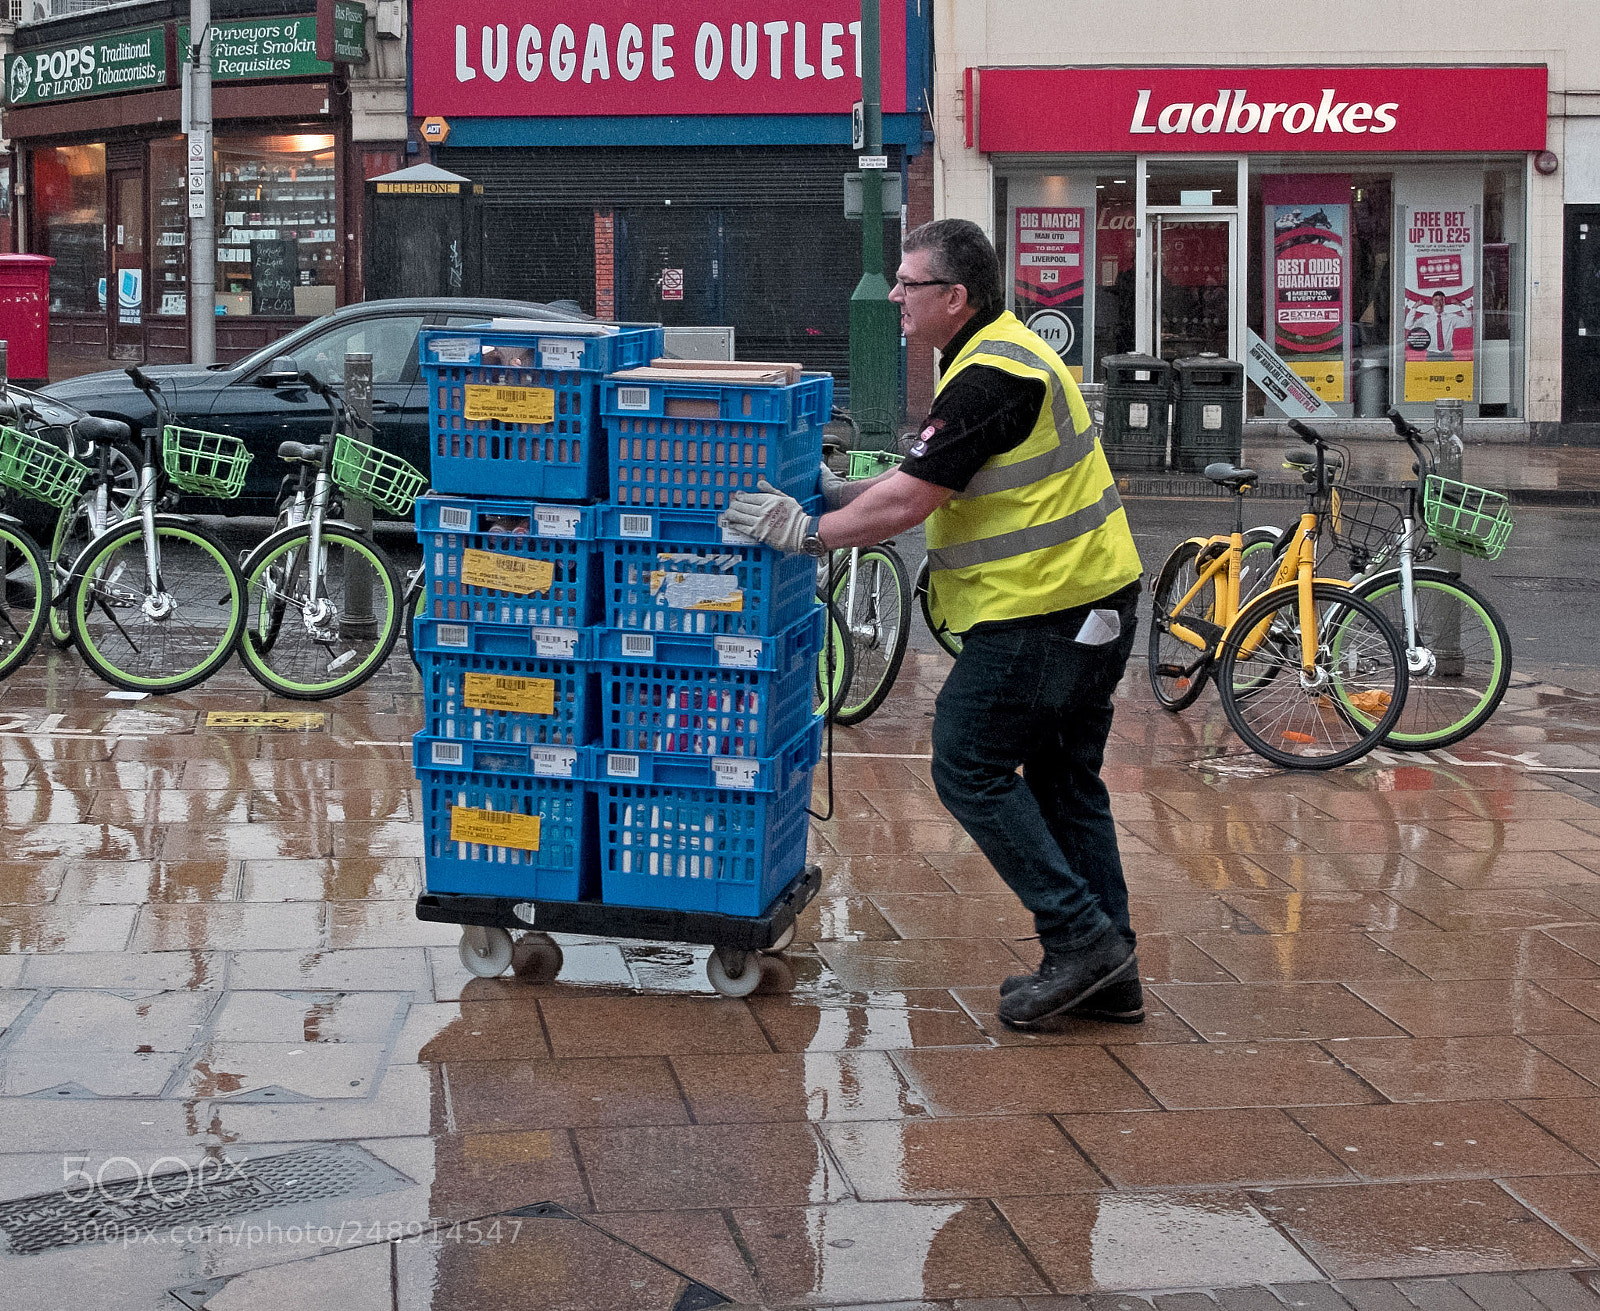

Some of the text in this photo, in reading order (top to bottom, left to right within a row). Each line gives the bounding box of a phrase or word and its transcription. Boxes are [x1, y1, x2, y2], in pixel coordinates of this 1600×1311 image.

[210, 22, 300, 42] Purveyors of
[101, 38, 151, 63] Traditional
[214, 43, 258, 57] Finest
[455, 21, 862, 84] LUGGAGE OUTLET
[35, 45, 95, 82] POPS
[217, 58, 291, 76] Requisites
[97, 62, 157, 85] Tobacconists
[38, 76, 93, 97] OF ILFORD
[1129, 89, 1399, 134] Ladbrokes
[427, 125, 440, 134] ADT
[386, 184, 452, 193] TELEPHONE
[1020, 213, 1081, 228] BIG MATCH
[1414, 212, 1465, 227] FREE BET
[1034, 232, 1065, 240] MAN UTD
[1409, 228, 1470, 243] UP TO £25
[1277, 258, 1340, 274] BEST ODDS
[1043, 272, 1056, 280] 2-0
[1277, 274, 1340, 288] GUARANTEED
[1286, 291, 1292, 301] 1
[1280, 311, 1290, 320] 2
[1036, 328, 1060, 339] 11/1
[1301, 399, 1317, 414] PLAY
